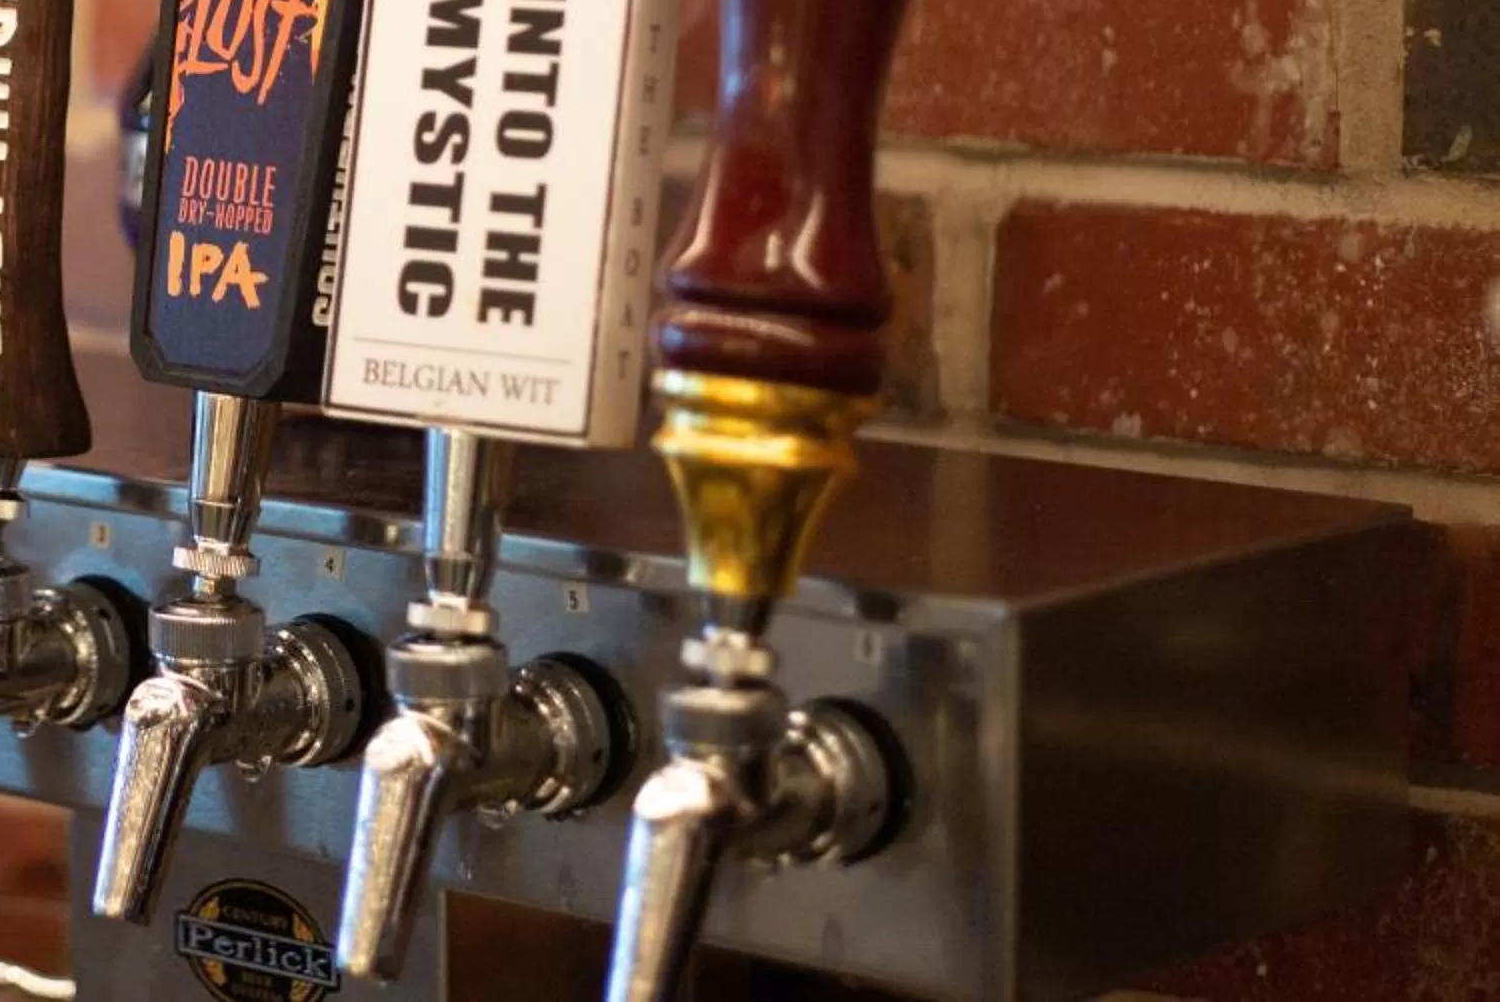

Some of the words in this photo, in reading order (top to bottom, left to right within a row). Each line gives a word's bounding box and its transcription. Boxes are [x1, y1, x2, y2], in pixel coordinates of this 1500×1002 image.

[182, 155, 277, 208] DOUBLE
[178, 196, 274, 236] DRY-HOPPED
[167, 229, 269, 310] IPA
[477, 183, 548, 328] THE
[363, 357, 490, 399] BELGIAN
[501, 372, 561, 405] WIT
[567, 589, 582, 610] 5
[188, 922, 329, 978] Perlick
